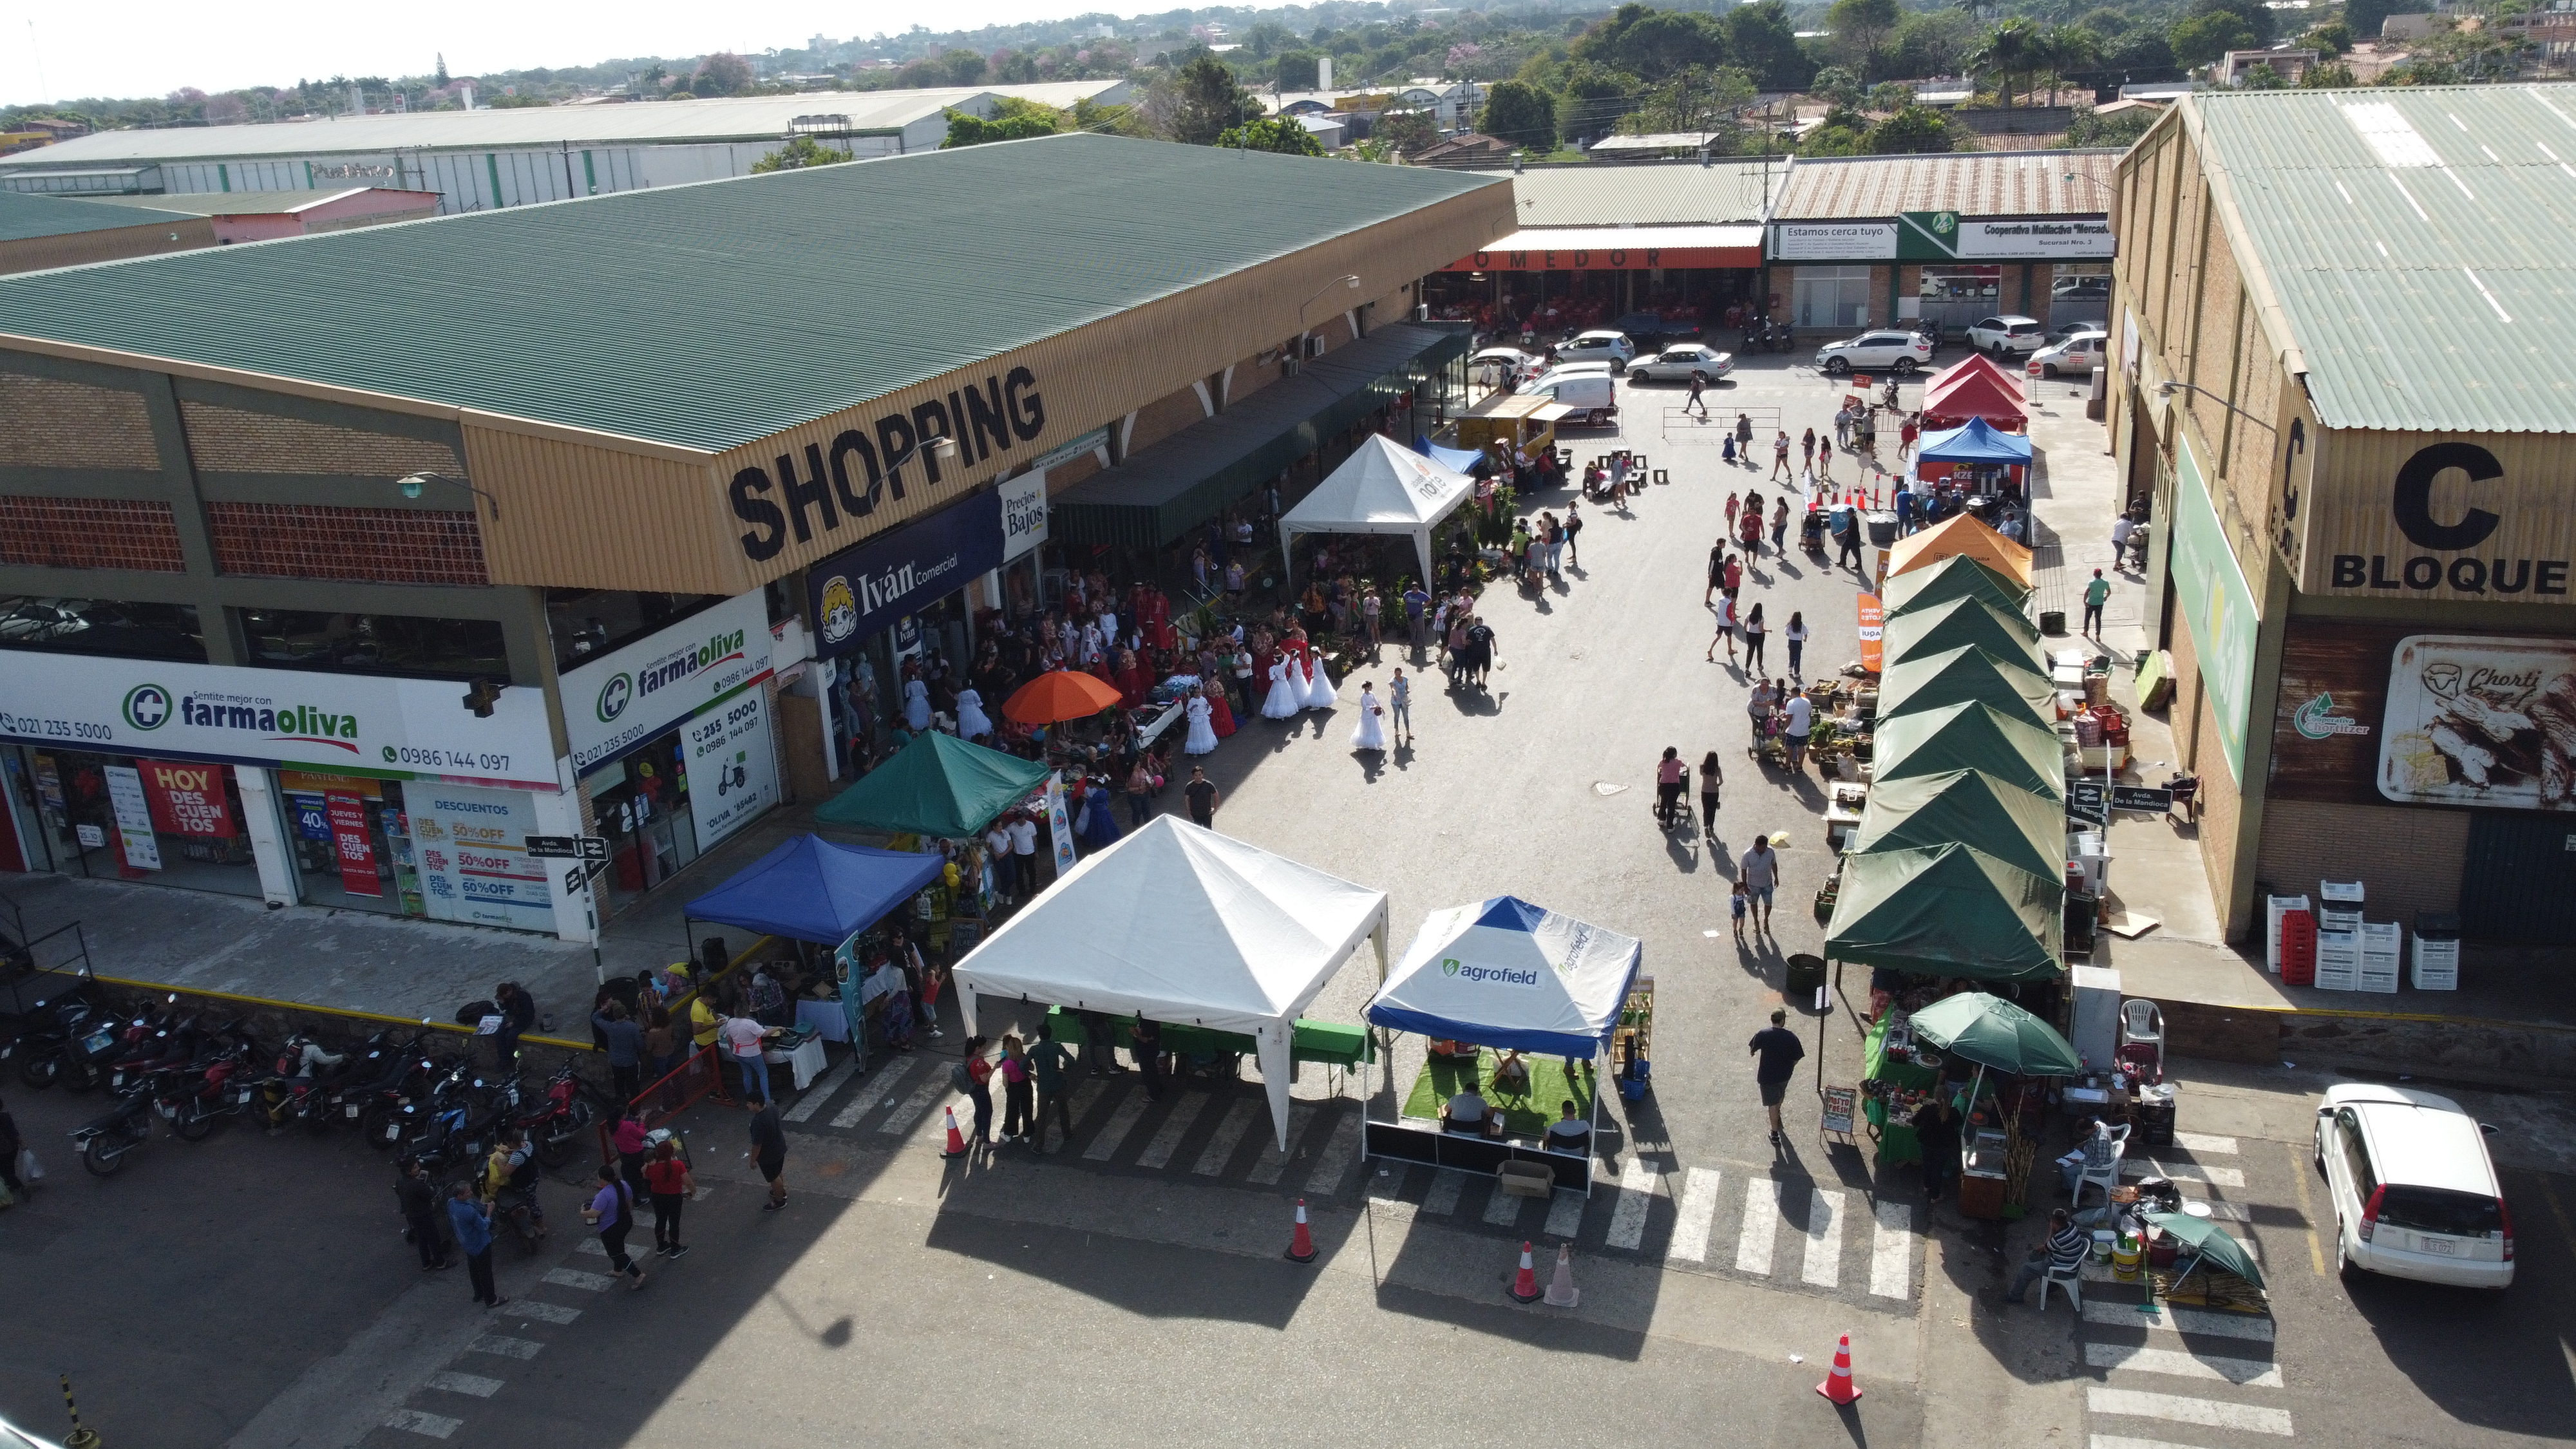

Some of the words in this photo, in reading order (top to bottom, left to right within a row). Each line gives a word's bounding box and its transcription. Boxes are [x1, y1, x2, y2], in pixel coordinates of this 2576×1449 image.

[1787, 227, 1829, 236] Estamos
[1832, 227, 1857, 236] cerca
[1861, 227, 1883, 237] tuyo
[1985, 224, 2029, 237] Cooperativa
[2032, 225, 2071, 234] Multiactiva
[1444, 247, 1660, 269] OMEDOR
[729, 366, 1045, 562] SHOPPING
[1419, 477, 1446, 500] norte
[2393, 442, 2503, 551] C
[1006, 491, 1036, 514] Precios
[1007, 506, 1043, 537] Bajos
[2331, 554, 2569, 596] BLOQUE
[857, 565, 915, 616] Iván
[638, 629, 744, 697] farmaoliva
[646, 656, 667, 671] Sentite
[668, 647, 685, 661] mejor
[686, 643, 696, 652] con
[721, 672, 740, 688] 0986
[741, 665, 754, 677] 144
[755, 656, 768, 670] 097
[2468, 668, 2543, 688] Chorti
[193, 691, 224, 701] Sentite
[227, 694, 252, 705] mejor
[255, 697, 272, 705] con
[182, 696, 357, 739] farmaoliva
[703, 719, 722, 739] 235
[728, 699, 757, 725] 5000
[17, 717, 42, 734] 021
[44, 720, 71, 736] 235
[75, 723, 112, 740] 5000
[706, 735, 726, 754] 0986
[729, 727, 743, 740] 144
[744, 717, 758, 732] 097
[2306, 723, 2369, 734] Chortitzer
[587, 745, 602, 761] 021
[604, 735, 620, 753] 235
[622, 723, 644, 743] 5000
[401, 747, 442, 766] 0986
[446, 751, 475, 768] 144
[480, 754, 509, 771] 097
[155, 768, 208, 791] HOY
[169, 790, 205, 805] DES
[435, 800, 508, 815] DESCUENTOS
[2134, 799, 2168, 808] Mandioca
[175, 805, 223, 819] CUEN
[302, 812, 328, 829] 40%
[330, 810, 357, 819] JUEVES
[178, 818, 215, 832] TOS
[334, 819, 364, 828] VIERNES
[419, 826, 443, 834] CUEN
[339, 833, 361, 843] DES
[341, 842, 370, 853] CUEN
[343, 851, 365, 861] TOS
[426, 857, 449, 866] CUEN
[431, 882, 452, 890] CUEN
[1564, 929, 1589, 971] agrofield
[1461, 965, 1537, 986] agrofield
[1829, 1104, 1848, 1113] FRESH
[1830, 1097, 1849, 1106] MOSTO
